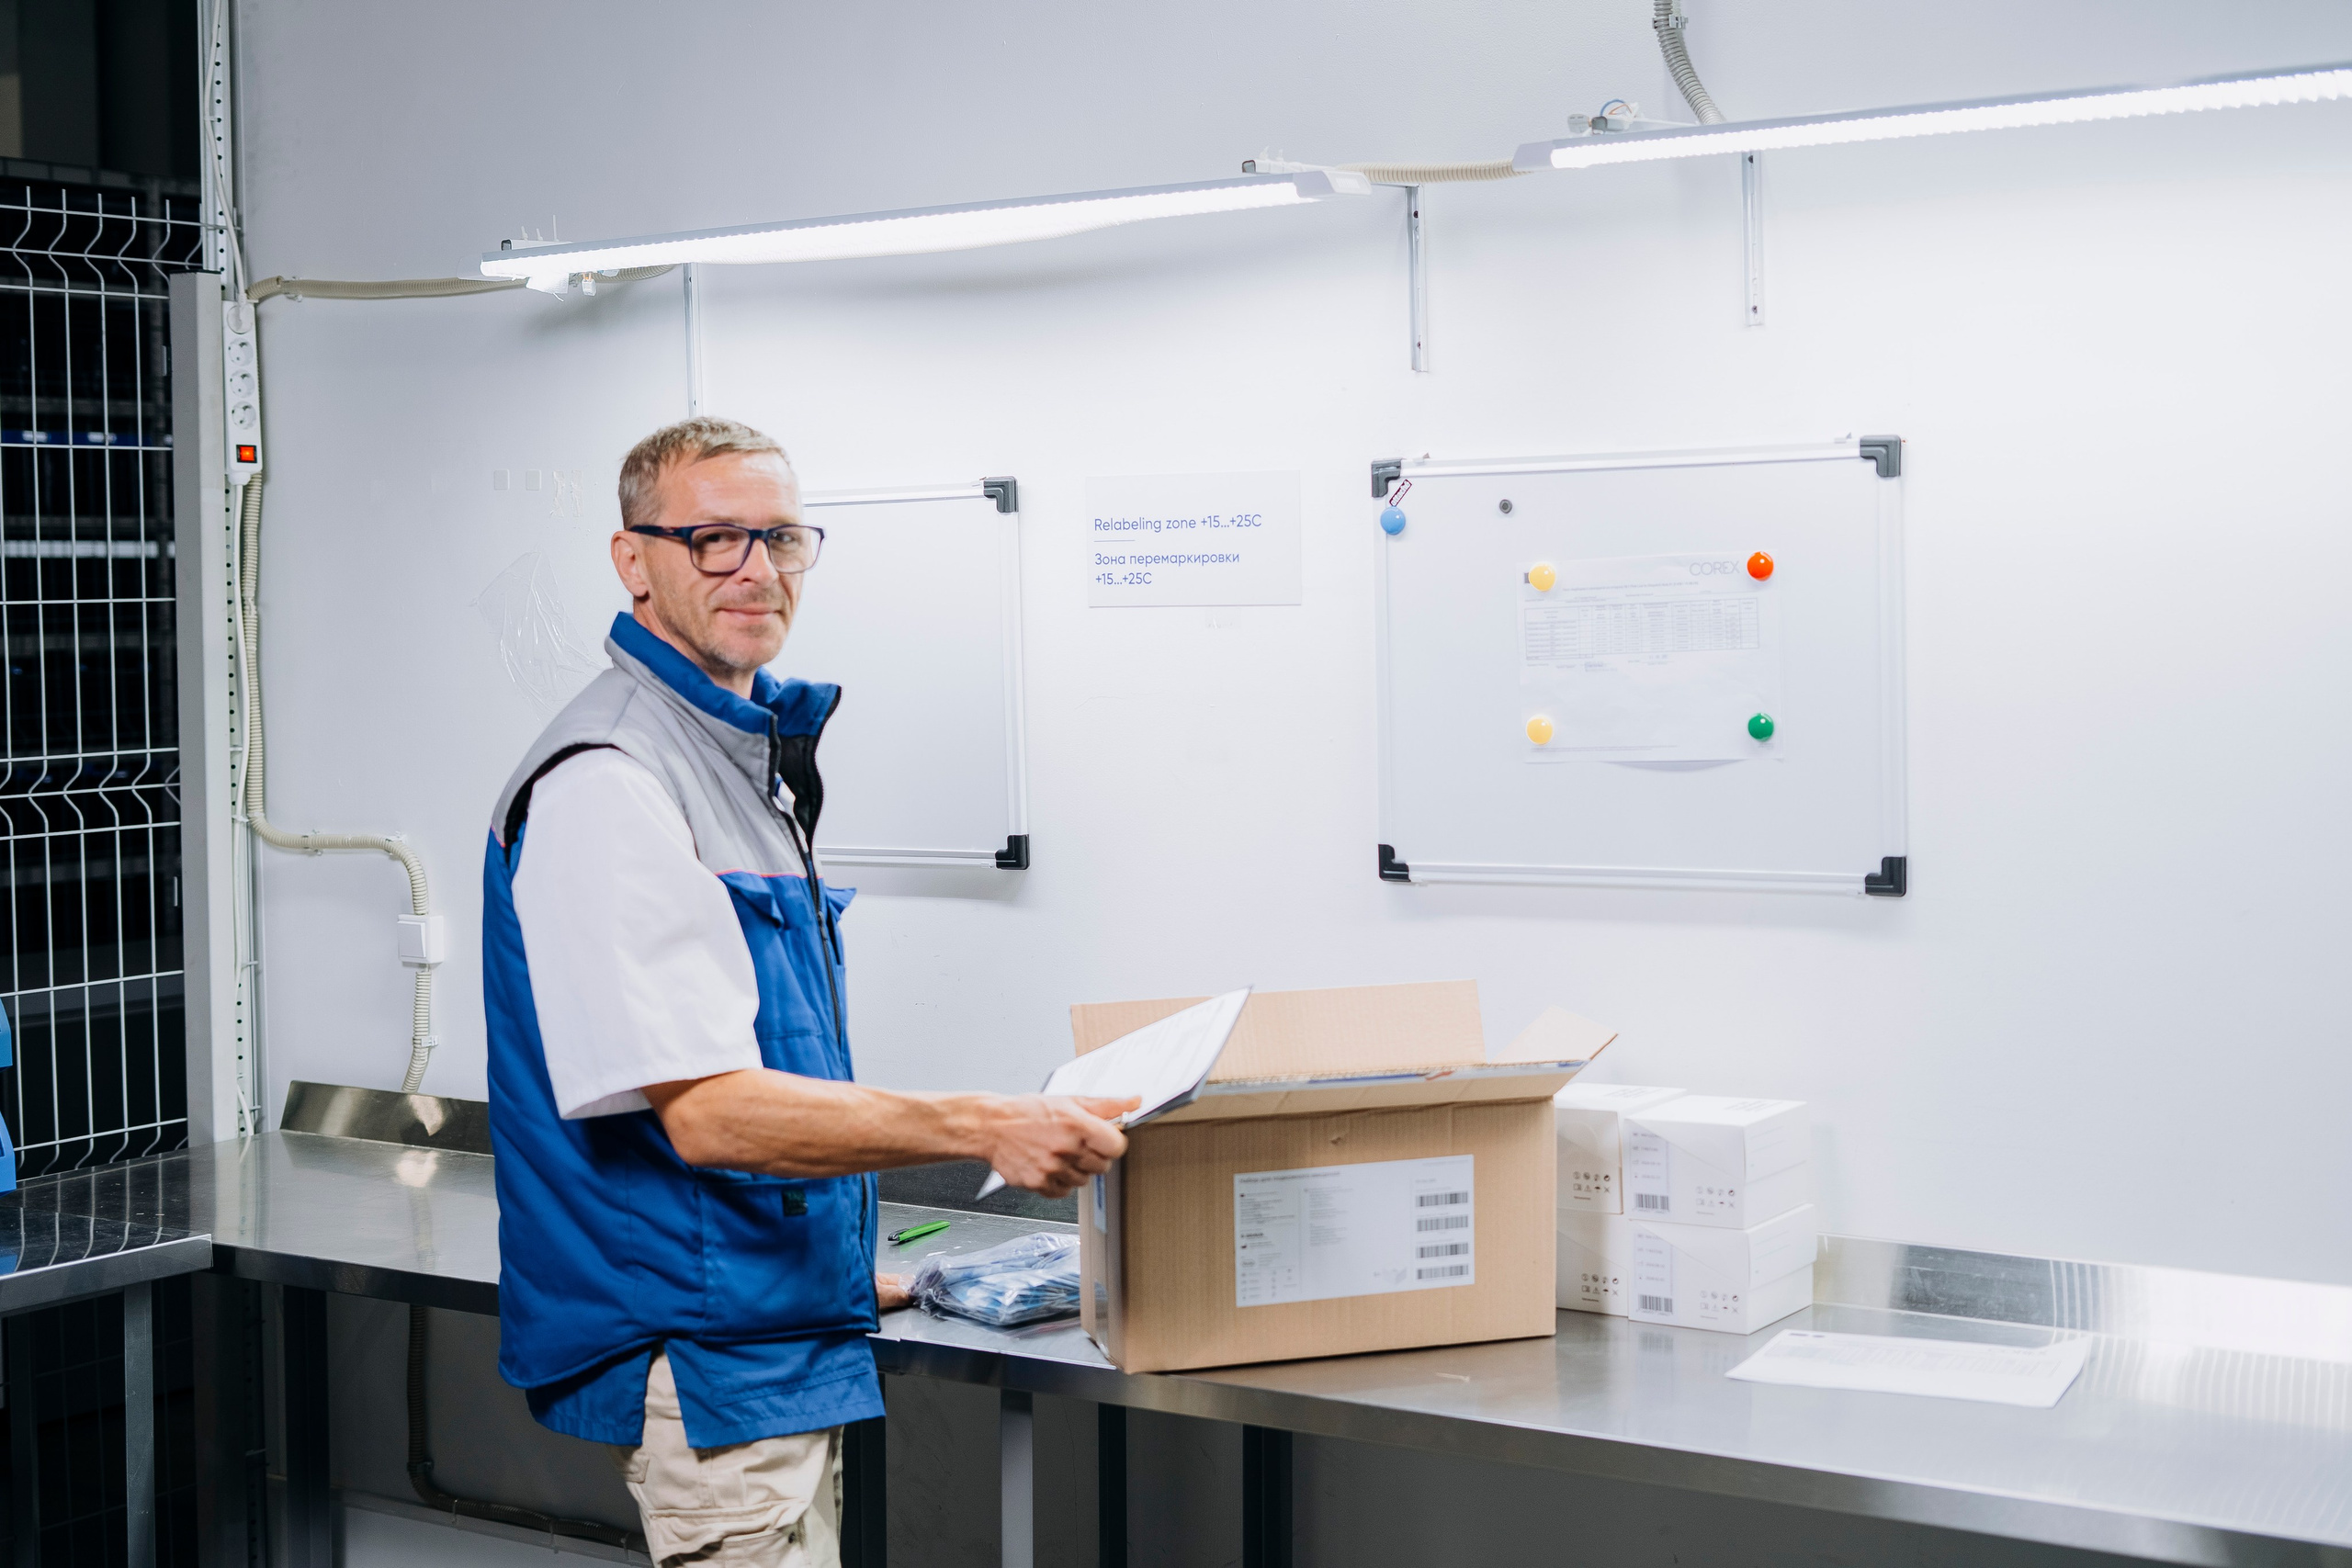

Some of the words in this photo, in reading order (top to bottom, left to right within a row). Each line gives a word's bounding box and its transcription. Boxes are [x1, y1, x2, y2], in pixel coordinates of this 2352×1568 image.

[1094, 517, 1161, 533] Relabeling
[1166, 518, 1196, 529] zone
[1201, 513, 1261, 528] +15...+25C
[1094, 553, 1125, 565] Зона
[1129, 553, 1239, 567] перемаркировки
[1689, 560, 1740, 576] COREX
[1095, 572, 1152, 585] +15...+25C
